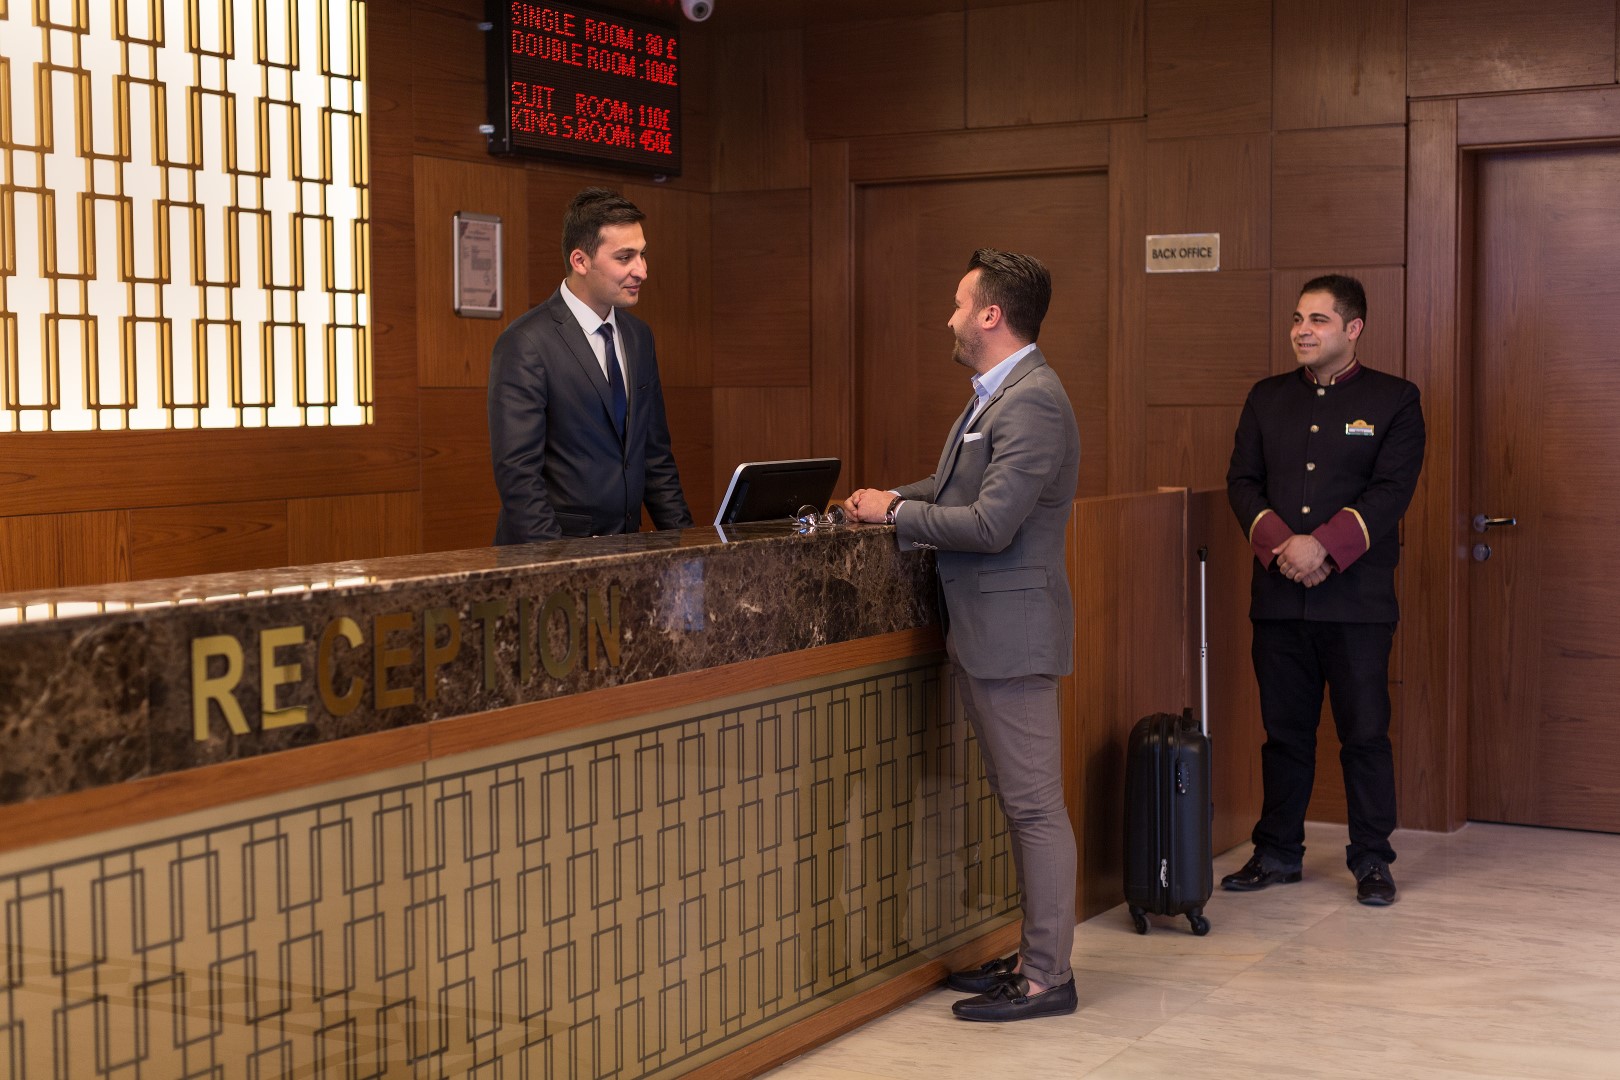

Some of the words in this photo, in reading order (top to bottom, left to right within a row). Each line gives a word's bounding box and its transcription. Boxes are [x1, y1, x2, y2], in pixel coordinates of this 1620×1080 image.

[512, 2, 575, 37] SINGLE
[512, 30, 583, 66] DOUBLE
[512, 81, 555, 110] SUIT
[512, 107, 557, 135] KING
[1152, 248, 1176, 259] BACK
[191, 585, 620, 741] RECEPTION
